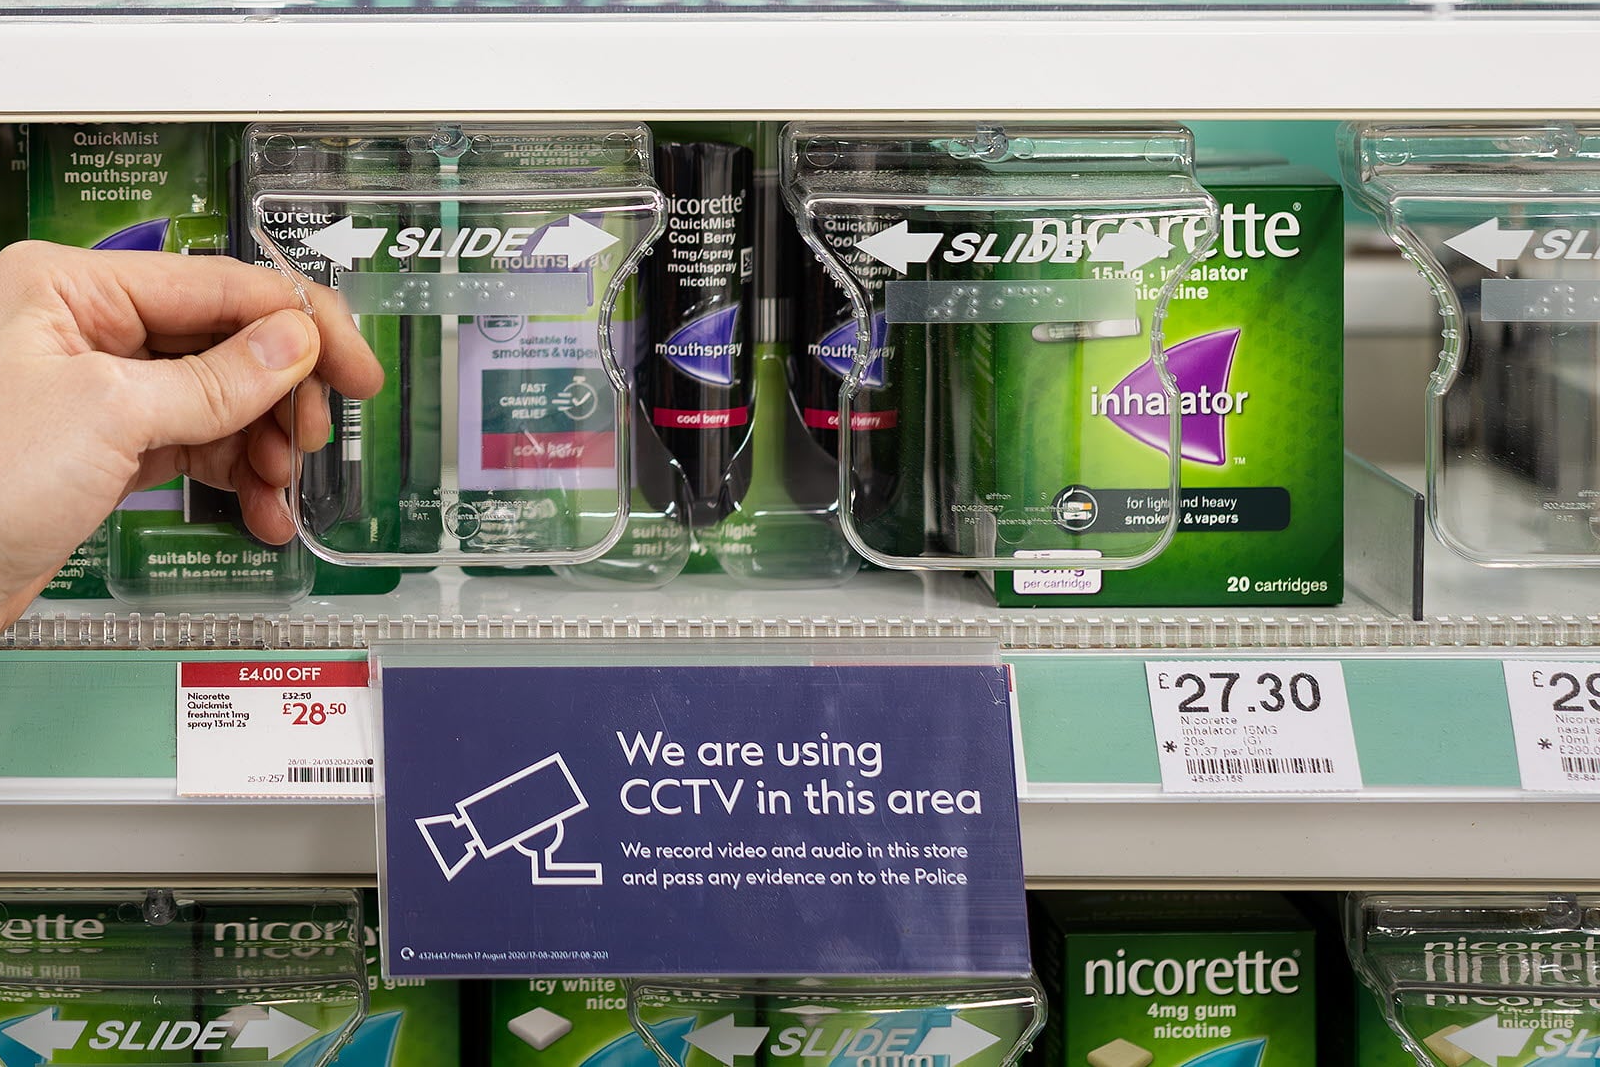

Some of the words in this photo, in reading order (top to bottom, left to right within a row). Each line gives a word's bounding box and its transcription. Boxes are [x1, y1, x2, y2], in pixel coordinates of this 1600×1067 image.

[73, 132, 159, 146] QuickMist
[70, 151, 163, 168] 1mg/spray
[64, 169, 168, 185] mouthspray
[81, 186, 152, 201] nicotine
[669, 218, 735, 230] QuickMist
[388, 228, 535, 258] SLIDE
[669, 232, 700, 244] Cool
[704, 232, 736, 245] Berry
[672, 249, 734, 261] 1mg/spray
[943, 232, 1091, 264] SLIDE
[667, 263, 737, 275] mouthspray
[680, 276, 727, 287] nicotine
[520, 337, 561, 345] suitable
[564, 336, 577, 345] for
[492, 348, 549, 359] smokers
[551, 348, 561, 359] &
[655, 341, 742, 358] mouthspray
[520, 384, 548, 393] FAST
[500, 397, 547, 407] CRAVING
[1090, 385, 1249, 416] inhaator
[512, 409, 547, 419] RELIEF
[677, 413, 701, 424] cool
[703, 413, 730, 425] berry
[1126, 497, 1143, 509] for
[1201, 497, 1238, 510] heavy
[1184, 513, 1193, 525] &
[1195, 514, 1239, 527] vapers
[148, 551, 211, 565] suitable
[215, 551, 238, 565] for
[243, 550, 278, 566] light
[1023, 579, 1042, 591] per
[1043, 578, 1092, 592] cartridge
[1227, 576, 1250, 592] 20
[1254, 577, 1328, 595] cartridges
[239, 667, 283, 681] £4.00
[287, 667, 321, 681] OFF
[187, 693, 230, 701] Nicorette
[282, 692, 311, 700] £32.50
[1158, 672, 1321, 713] £27.30
[187, 702, 233, 711] Quickmist
[282, 702, 347, 725] £28.50
[187, 711, 230, 719] freshmint
[231, 711, 250, 721] 1mg
[187, 721, 212, 729] spray
[214, 720, 234, 728] 13ml
[237, 720, 247, 728] 2s
[1182, 726, 1237, 735] inhalator
[616, 730, 685, 766] We
[697, 742, 764, 766] are
[776, 732, 884, 777] using
[1223, 748, 1244, 758] per
[619, 778, 745, 815] CCTV
[756, 780, 791, 814] in
[803, 778, 876, 815] this
[887, 789, 982, 815] area
[620, 841, 651, 858] We
[656, 841, 713, 858] record
[717, 841, 767, 858] video
[771, 841, 807, 858] and
[811, 841, 862, 858] audio
[867, 842, 883, 858] in
[887, 841, 919, 858] this
[923, 843, 968, 858] store
[622, 869, 657, 885] and
[662, 872, 704, 890] pass
[708, 872, 741, 890] any
[745, 868, 826, 885] evidence
[830, 873, 853, 885] on
[857, 870, 876, 885] to
[880, 868, 910, 885] the
[914, 868, 968, 885] Police
[483, 951, 507, 962] August
[1084, 948, 1300, 996] nicorette
[530, 978, 557, 995] icy
[563, 978, 616, 991] white
[1147, 1003, 1189, 1021] 4mg
[1194, 1004, 1236, 1021] gum
[88, 1020, 235, 1050] SLIDE
[1154, 1023, 1231, 1038] nicotine
[770, 1028, 917, 1057] SLIDE
